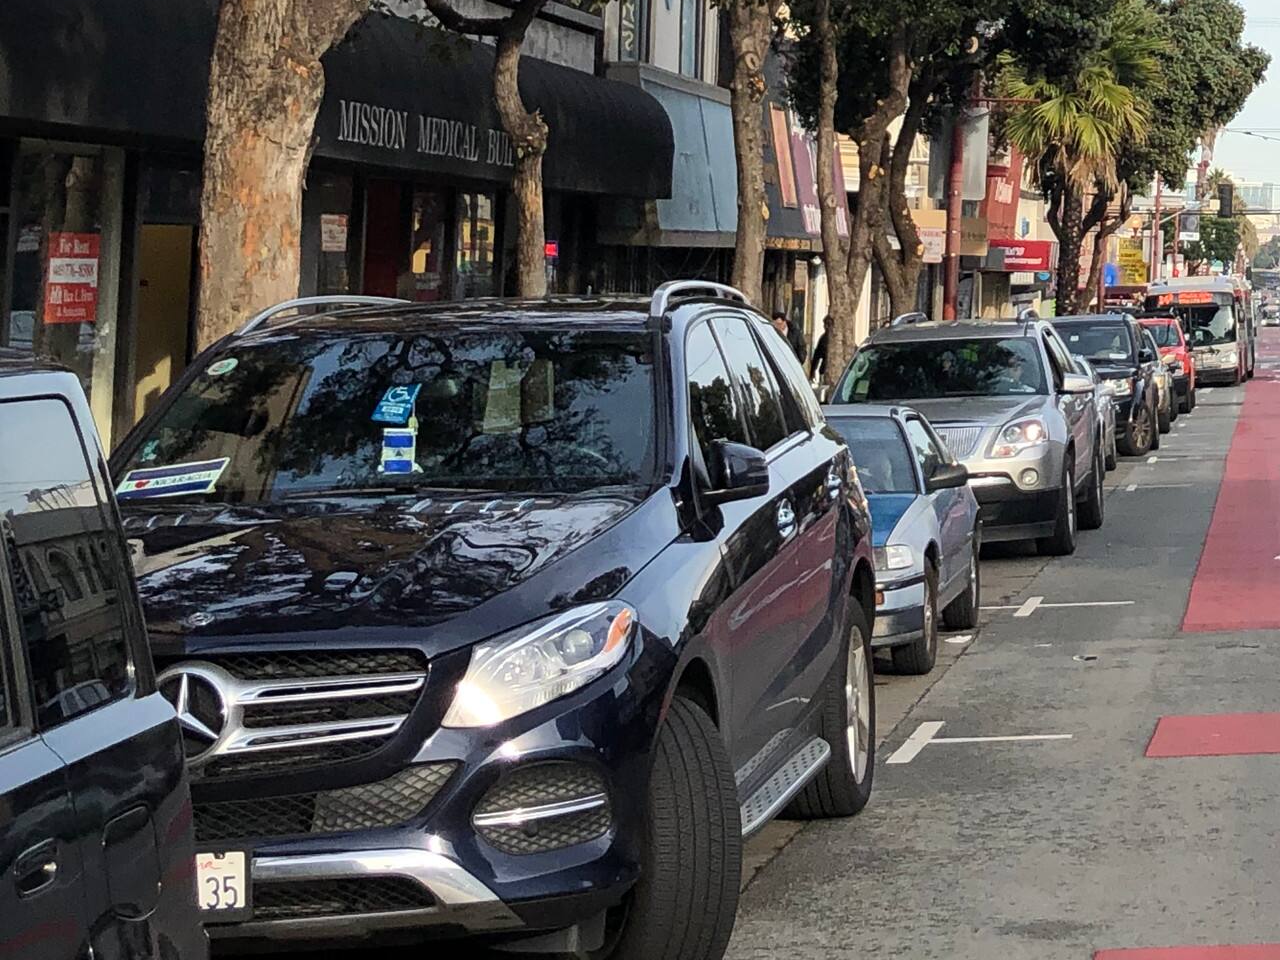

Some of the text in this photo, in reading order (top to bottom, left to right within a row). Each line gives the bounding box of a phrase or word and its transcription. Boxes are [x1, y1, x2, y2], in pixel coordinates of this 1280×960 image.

[337, 99, 514, 167] MISSION MEDICAL BUIL
[205, 876, 239, 910] 35
